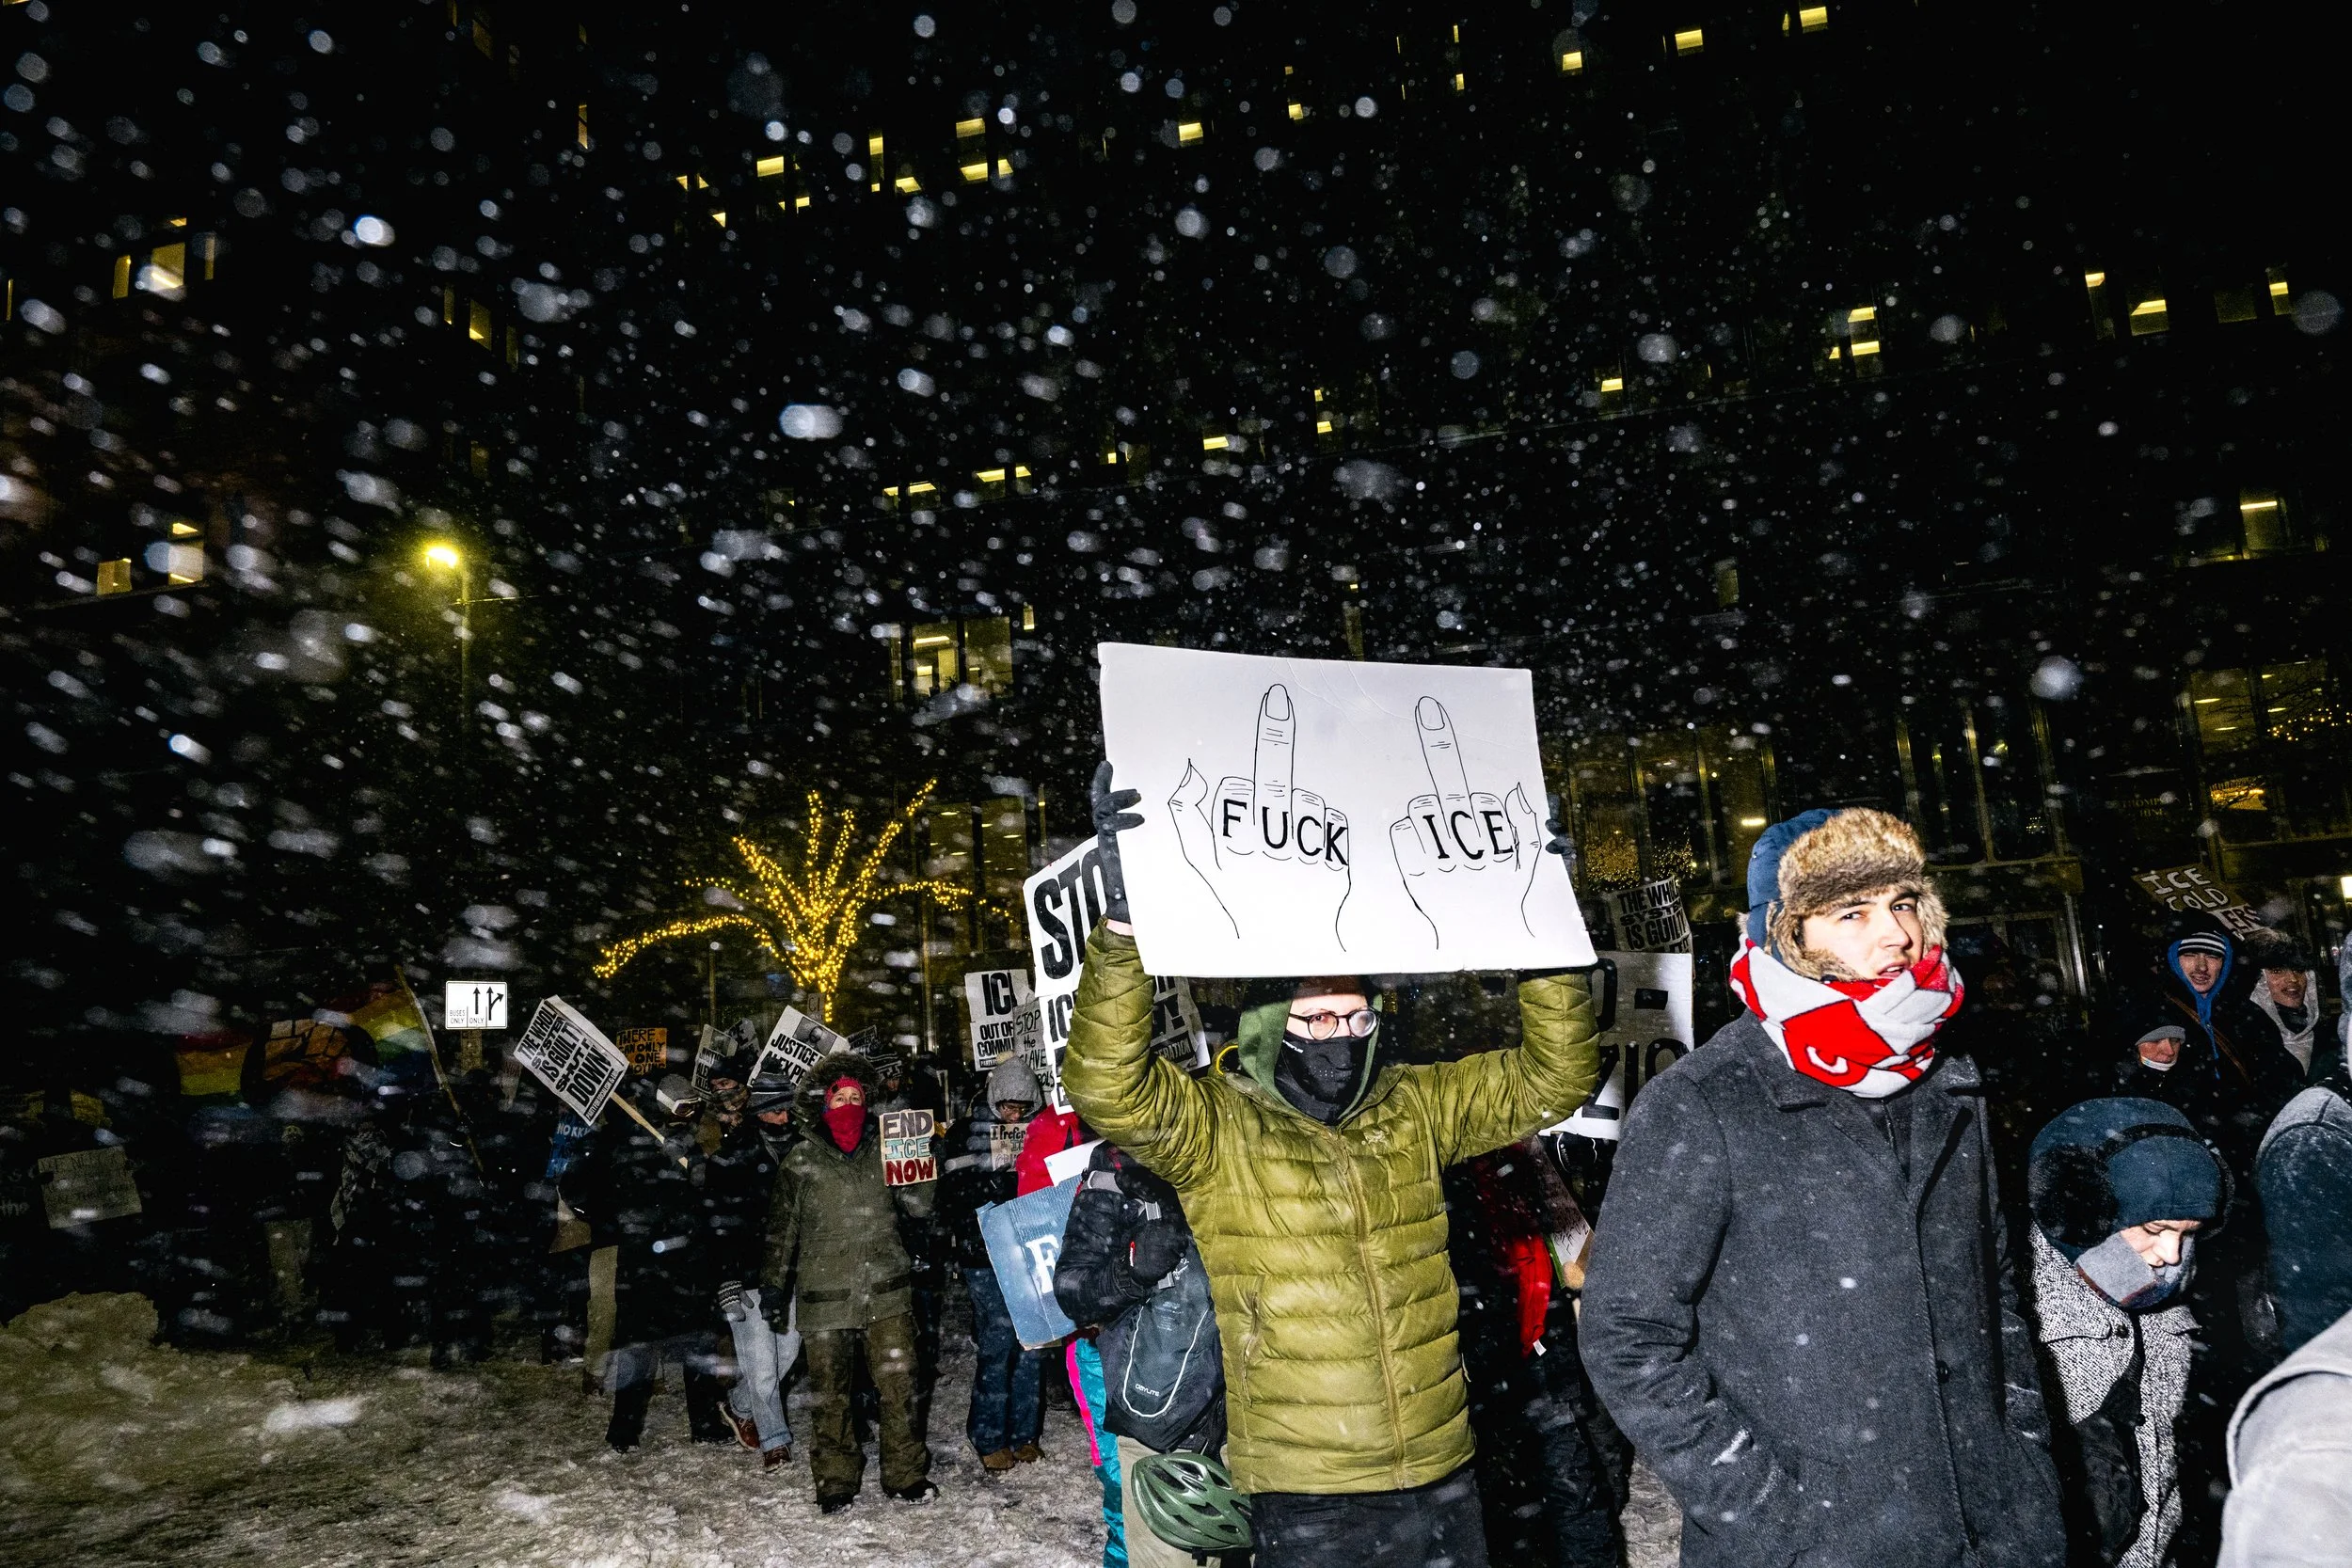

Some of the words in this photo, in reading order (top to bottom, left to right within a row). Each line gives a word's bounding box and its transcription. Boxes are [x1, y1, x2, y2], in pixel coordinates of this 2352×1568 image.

[1223, 799, 1348, 865] FUCK
[1422, 810, 1514, 860] ICE
[2141, 867, 2211, 895] ICE
[1617, 889, 1647, 915] THE
[2166, 888, 2229, 911] COLD
[1034, 847, 1107, 979] STO
[1626, 924, 1645, 951] IS
[1016, 1009, 1041, 1036] STOP
[1047, 991, 1076, 1043] IC
[517, 1034, 540, 1060] THE
[529, 1001, 557, 1041] WHOL
[617, 1029, 656, 1045] THERE
[979, 1022, 999, 1041] OUT
[1024, 1036, 1036, 1051] the
[635, 1053, 660, 1063] ONE
[637, 1041, 665, 1053] ONLY
[771, 1033, 818, 1067] JUSTICE
[539, 1060, 559, 1083] IS
[556, 1046, 584, 1093] SHUT
[566, 1044, 612, 1107] DOWN
[556, 1122, 571, 1135] NO
[883, 1112, 932, 1138] END
[991, 1125, 998, 1140] I
[1000, 1125, 1025, 1140] Prefer
[885, 1136, 931, 1160] ICE
[886, 1157, 934, 1184] NOW
